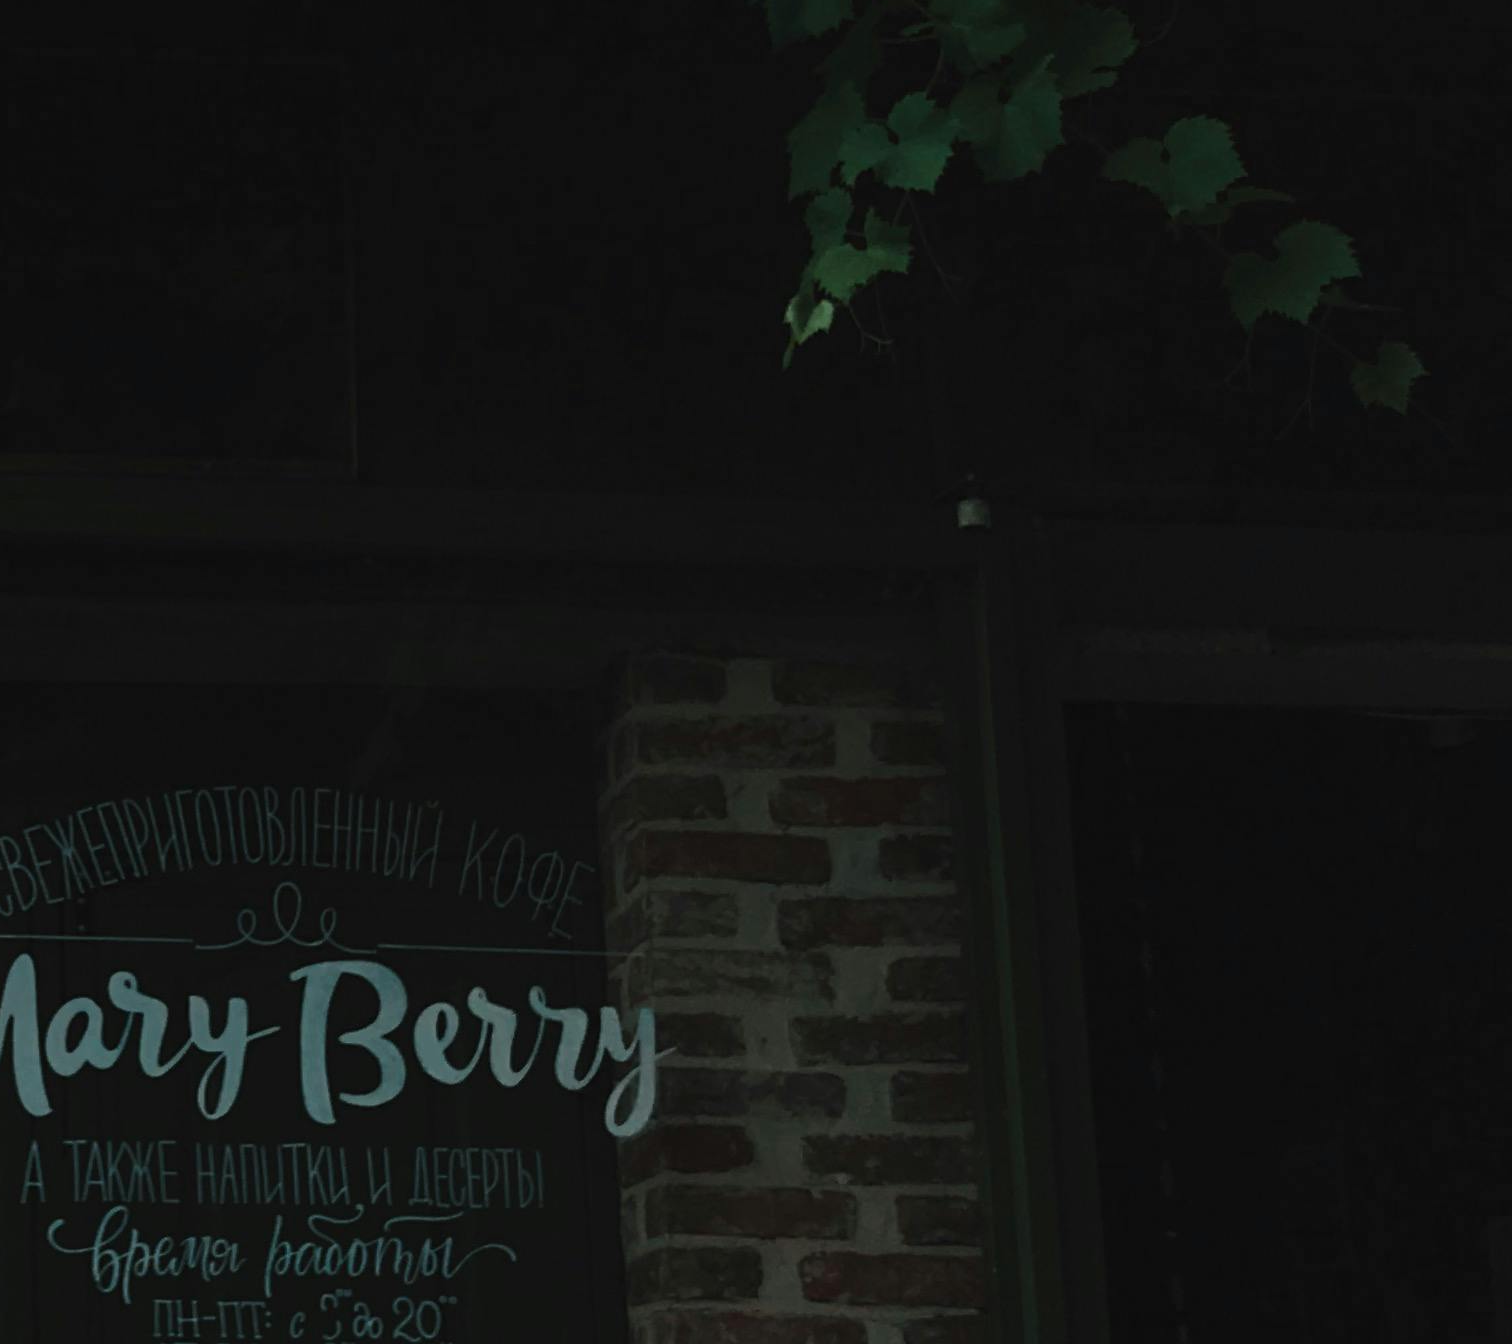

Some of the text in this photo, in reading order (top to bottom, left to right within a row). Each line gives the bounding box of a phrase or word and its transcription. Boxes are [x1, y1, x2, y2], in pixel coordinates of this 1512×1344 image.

[458, 818, 596, 941] КОФЕ
[288, 958, 678, 1138] Berry
[19, 1139, 546, 1210] А ТАКЖЕ НАПИТКИ И ДЕСЕРТЫ
[46, 1203, 518, 1305] время работы
[351, 1301, 384, 1340] до
